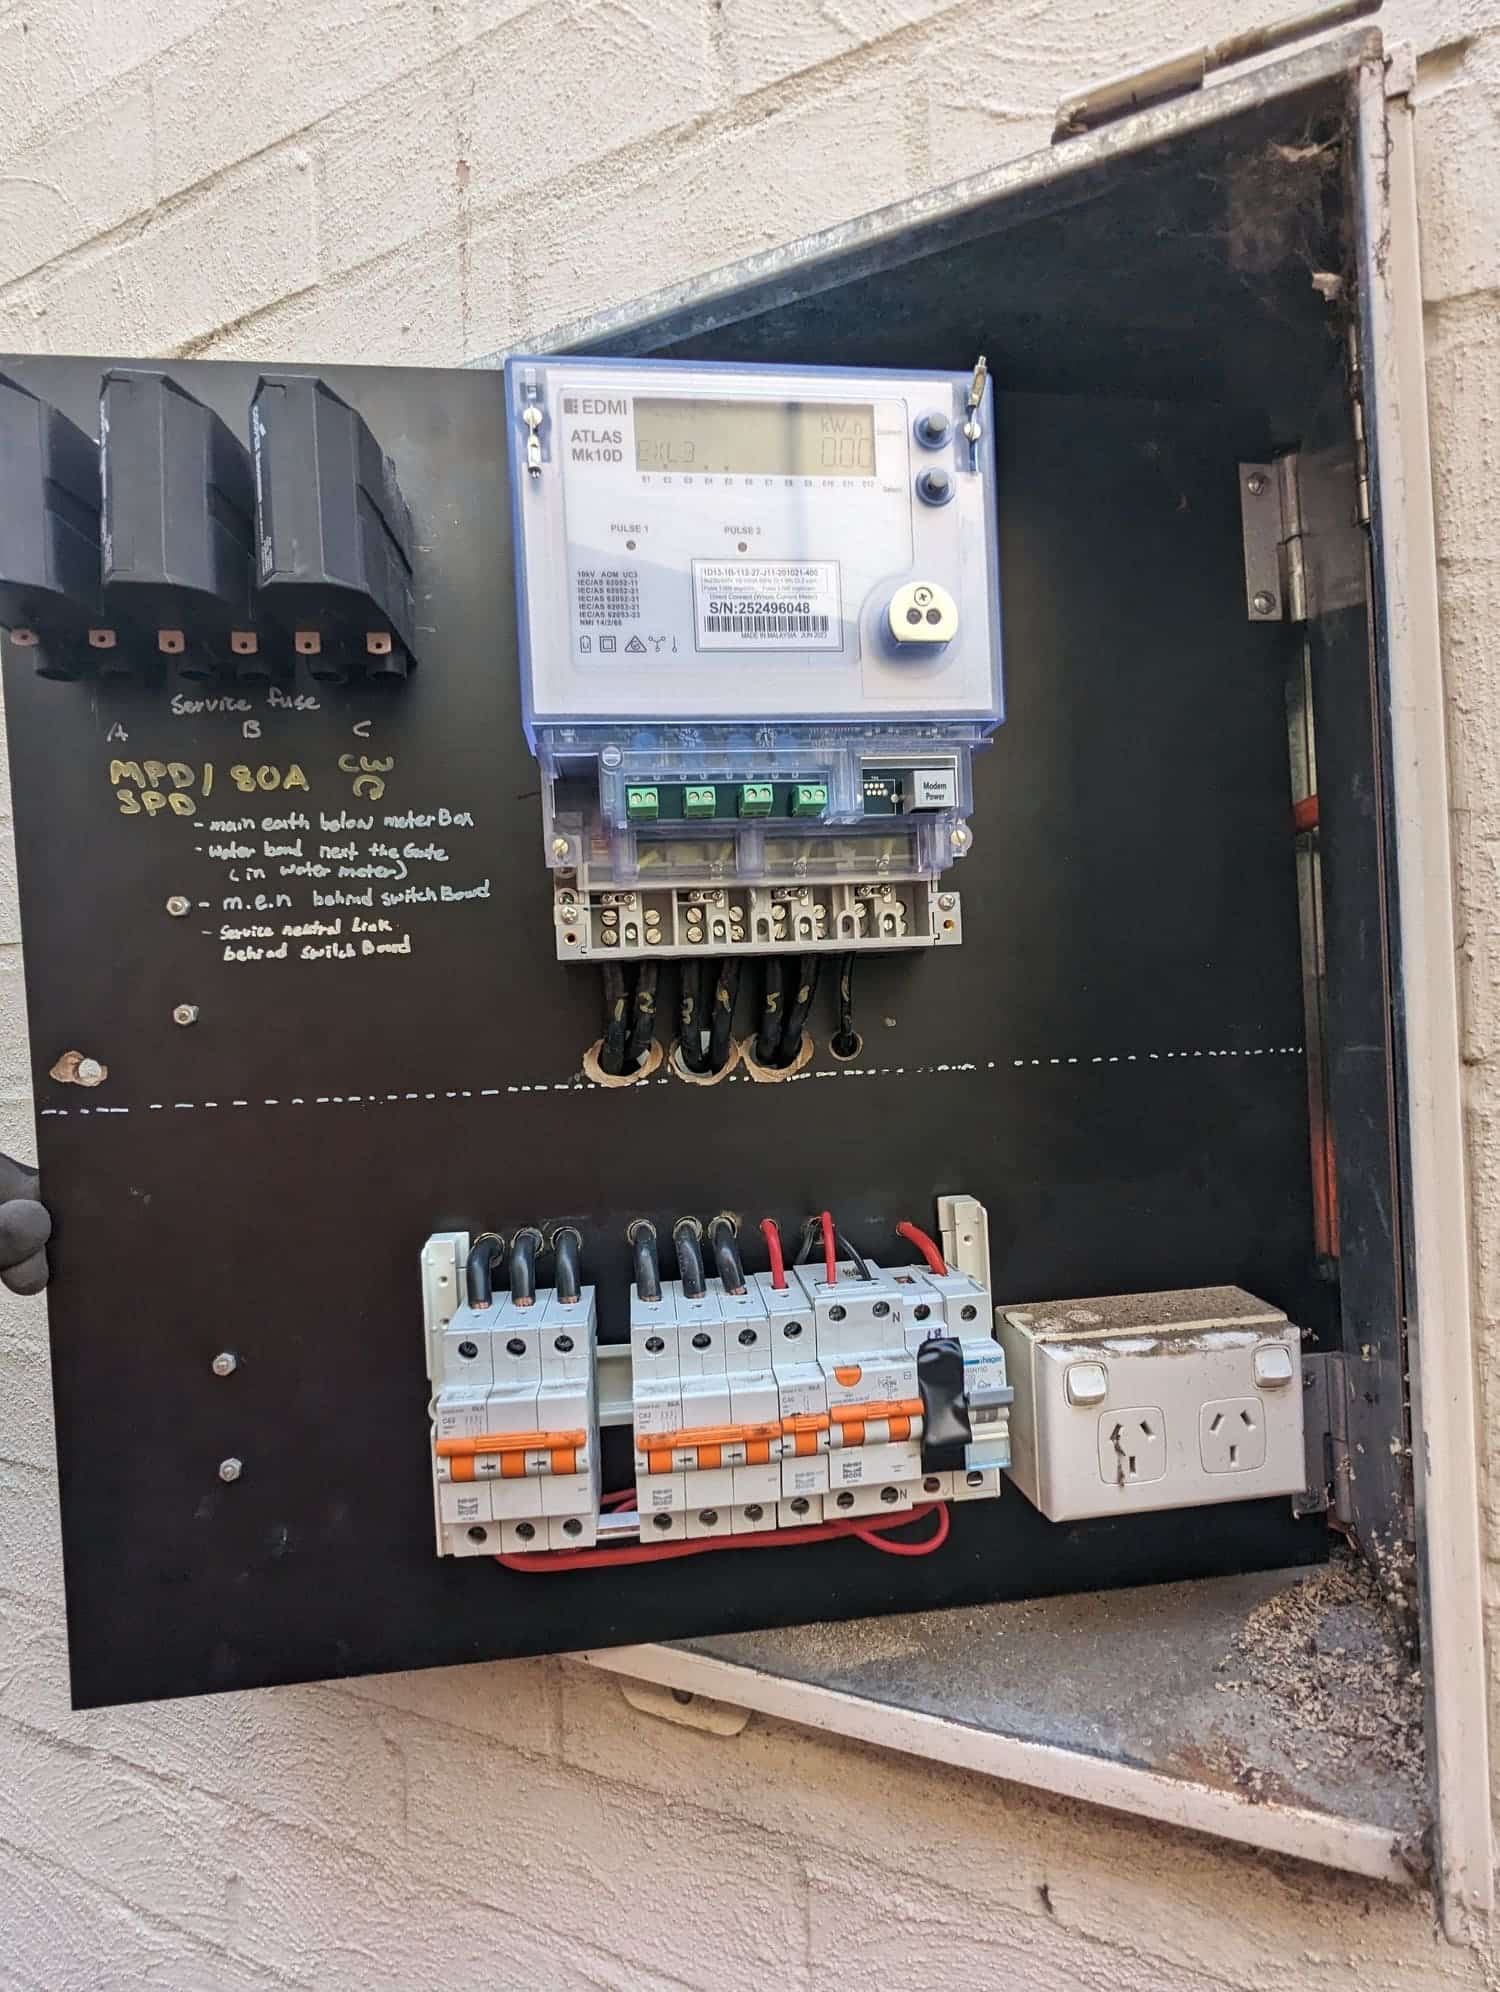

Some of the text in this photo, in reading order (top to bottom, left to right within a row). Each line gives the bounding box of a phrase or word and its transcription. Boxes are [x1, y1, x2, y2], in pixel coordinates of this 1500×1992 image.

[582, 399, 627, 415] EDMI
[571, 429, 622, 444] ATLAS
[572, 448, 623, 463] Mk10D
[610, 523, 641, 534] PULSE
[724, 526, 754, 535] PULSE
[577, 578, 604, 586] IEC/AS
[579, 603, 606, 611] IEC/AS
[709, 601, 811, 615] S/N:252496048
[171, 693, 252, 716] Service
[106, 721, 130, 743] A
[242, 719, 262, 739] B
[230, 763, 310, 792] 80A
[923, 781, 947, 790] Modem
[116, 789, 197, 817] SPD
[926, 792, 945, 801] Power
[209, 817, 256, 832] main
[261, 811, 310, 832] earth
[320, 810, 374, 832] below
[766, 991, 781, 1014] 5
[892, 1311, 901, 1323] N
[900, 1487, 908, 1500] N
